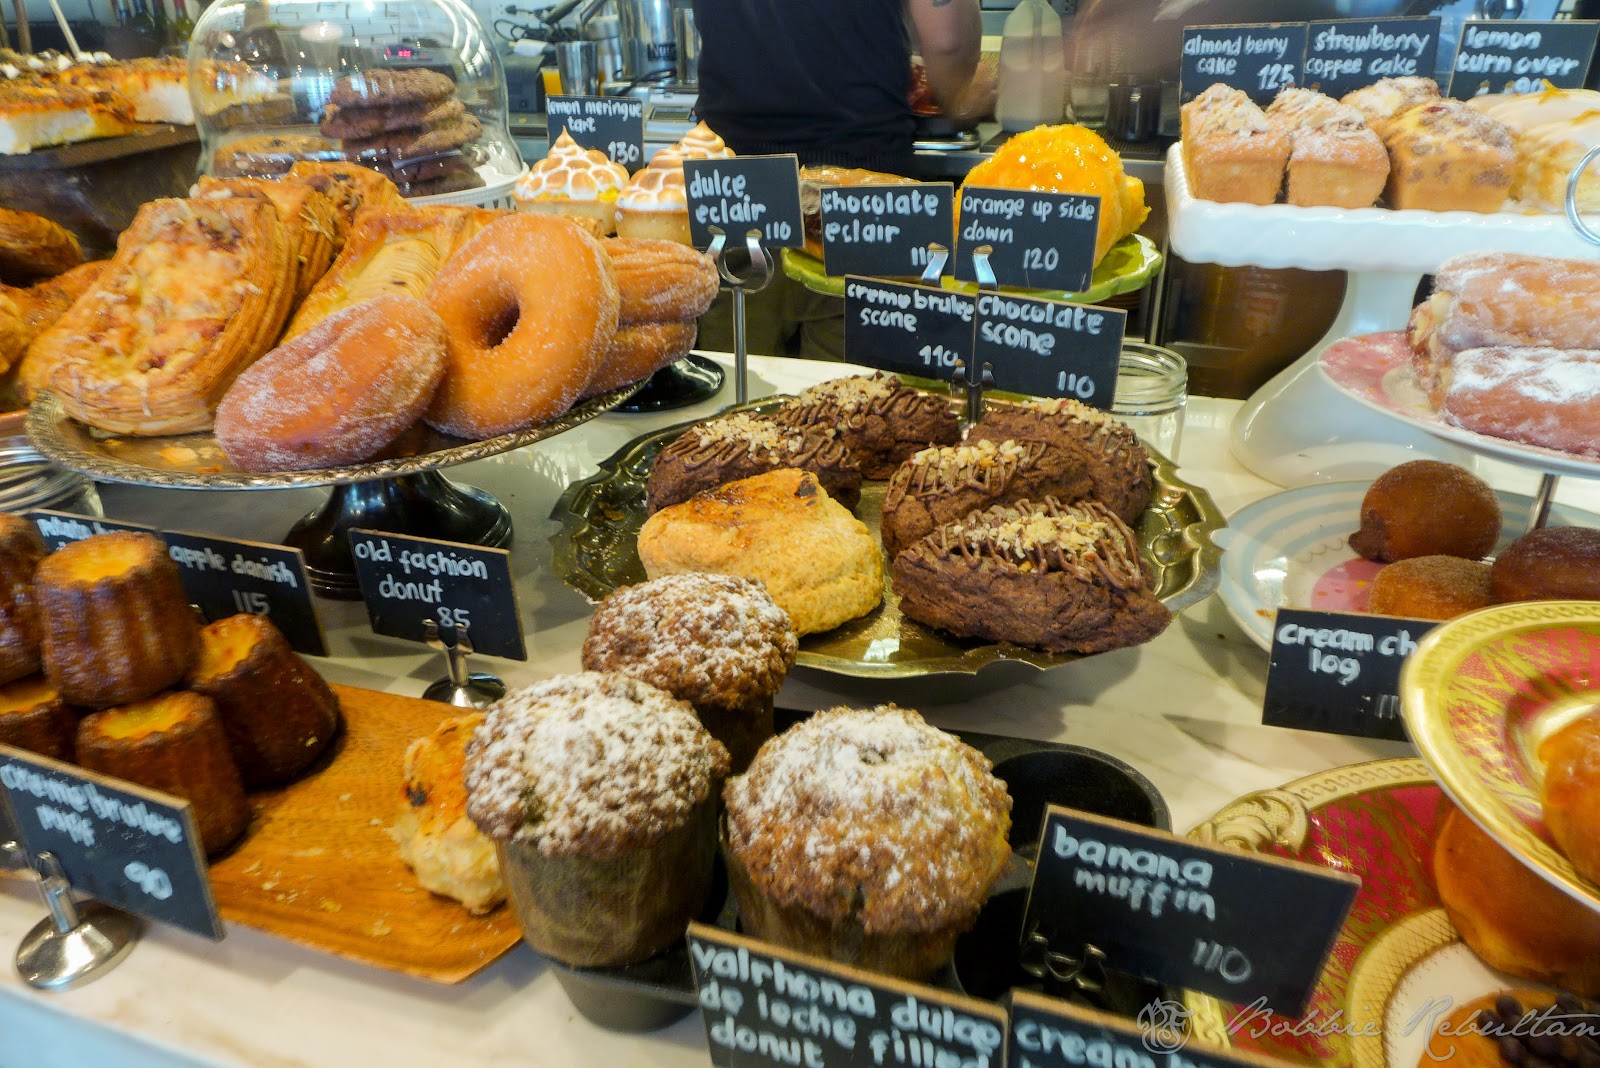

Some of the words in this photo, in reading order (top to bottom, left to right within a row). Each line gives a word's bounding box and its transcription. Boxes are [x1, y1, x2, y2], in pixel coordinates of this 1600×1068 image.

[1184, 34, 1242, 56] almond
[1244, 34, 1289, 60] berry
[1313, 24, 1430, 57] strawberry
[1463, 26, 1542, 50] lemon
[1196, 57, 1237, 75] cake
[1257, 63, 1295, 90] 125
[1303, 57, 1363, 80] coffee
[1367, 52, 1417, 76] cake
[547, 98, 581, 116] lemon
[585, 100, 642, 121] meringue
[567, 116, 596, 133] tart
[608, 141, 640, 165] 130
[690, 169, 747, 199] dulce
[696, 193, 766, 224] eclair
[821, 190, 939, 216] chocolate
[963, 195, 1025, 220] orange
[1032, 202, 1052, 222] up
[1058, 197, 1095, 221] side
[765, 221, 792, 241] 110
[825, 217, 901, 243] eclair
[962, 220, 1014, 243] down
[1023, 247, 1059, 271] 120
[860, 307, 917, 333] scone
[980, 320, 1056, 356] scone
[918, 345, 959, 367] 110
[1057, 370, 1096, 399] 110
[169, 545, 227, 571] apple
[231, 553, 298, 588] danish
[354, 539, 393, 562] old
[399, 550, 488, 579] fashion
[379, 573, 443, 603] donut
[232, 589, 270, 615] 115
[437, 606, 471, 629] 85
[1276, 623, 1375, 652] cream
[1376, 629, 1418, 656] ch
[1308, 648, 1361, 686] log
[1374, 694, 1399, 720] 11
[1053, 823, 1214, 889] banana
[1074, 867, 1216, 922] muffin
[1192, 938, 1252, 984] 110
[691, 939, 876, 1018] valrhona
[891, 993, 1001, 1057] dulce
[700, 977, 744, 1016] de
[710, 1013, 825, 1068] donut
[1014, 1019, 1156, 1068] cream
